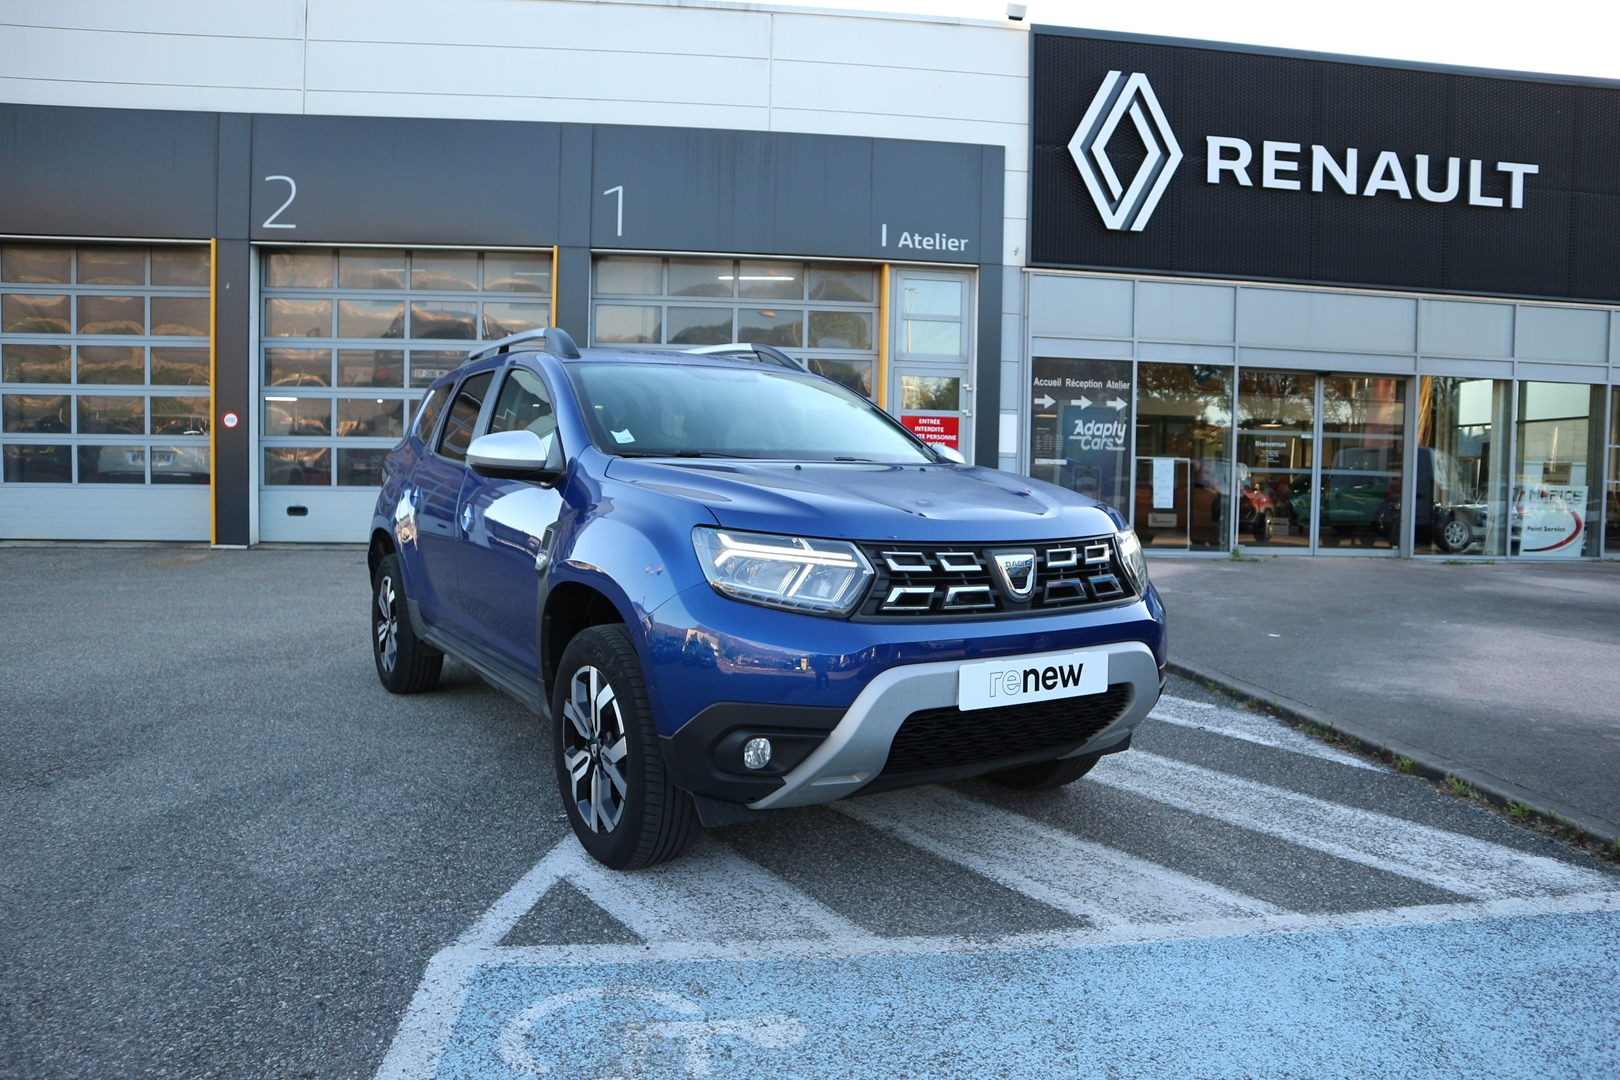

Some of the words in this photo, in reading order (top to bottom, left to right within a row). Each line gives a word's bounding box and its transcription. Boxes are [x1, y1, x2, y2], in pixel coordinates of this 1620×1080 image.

[1206, 135, 1539, 209] RENAULT
[263, 175, 297, 229] 2
[603, 185, 624, 237] 1
[897, 231, 969, 252] Atelier
[1033, 377, 1062, 387] Accueil
[1065, 378, 1103, 390] Réception
[1106, 380, 1131, 390] Atelier
[1073, 419, 1127, 444] Adapty
[1069, 435, 1126, 451] Cars
[1254, 440, 1287, 448] Bienvenue
[1543, 525, 1566, 533] Service
[1005, 560, 1032, 568] DACIA
[989, 663, 1084, 698] renew
